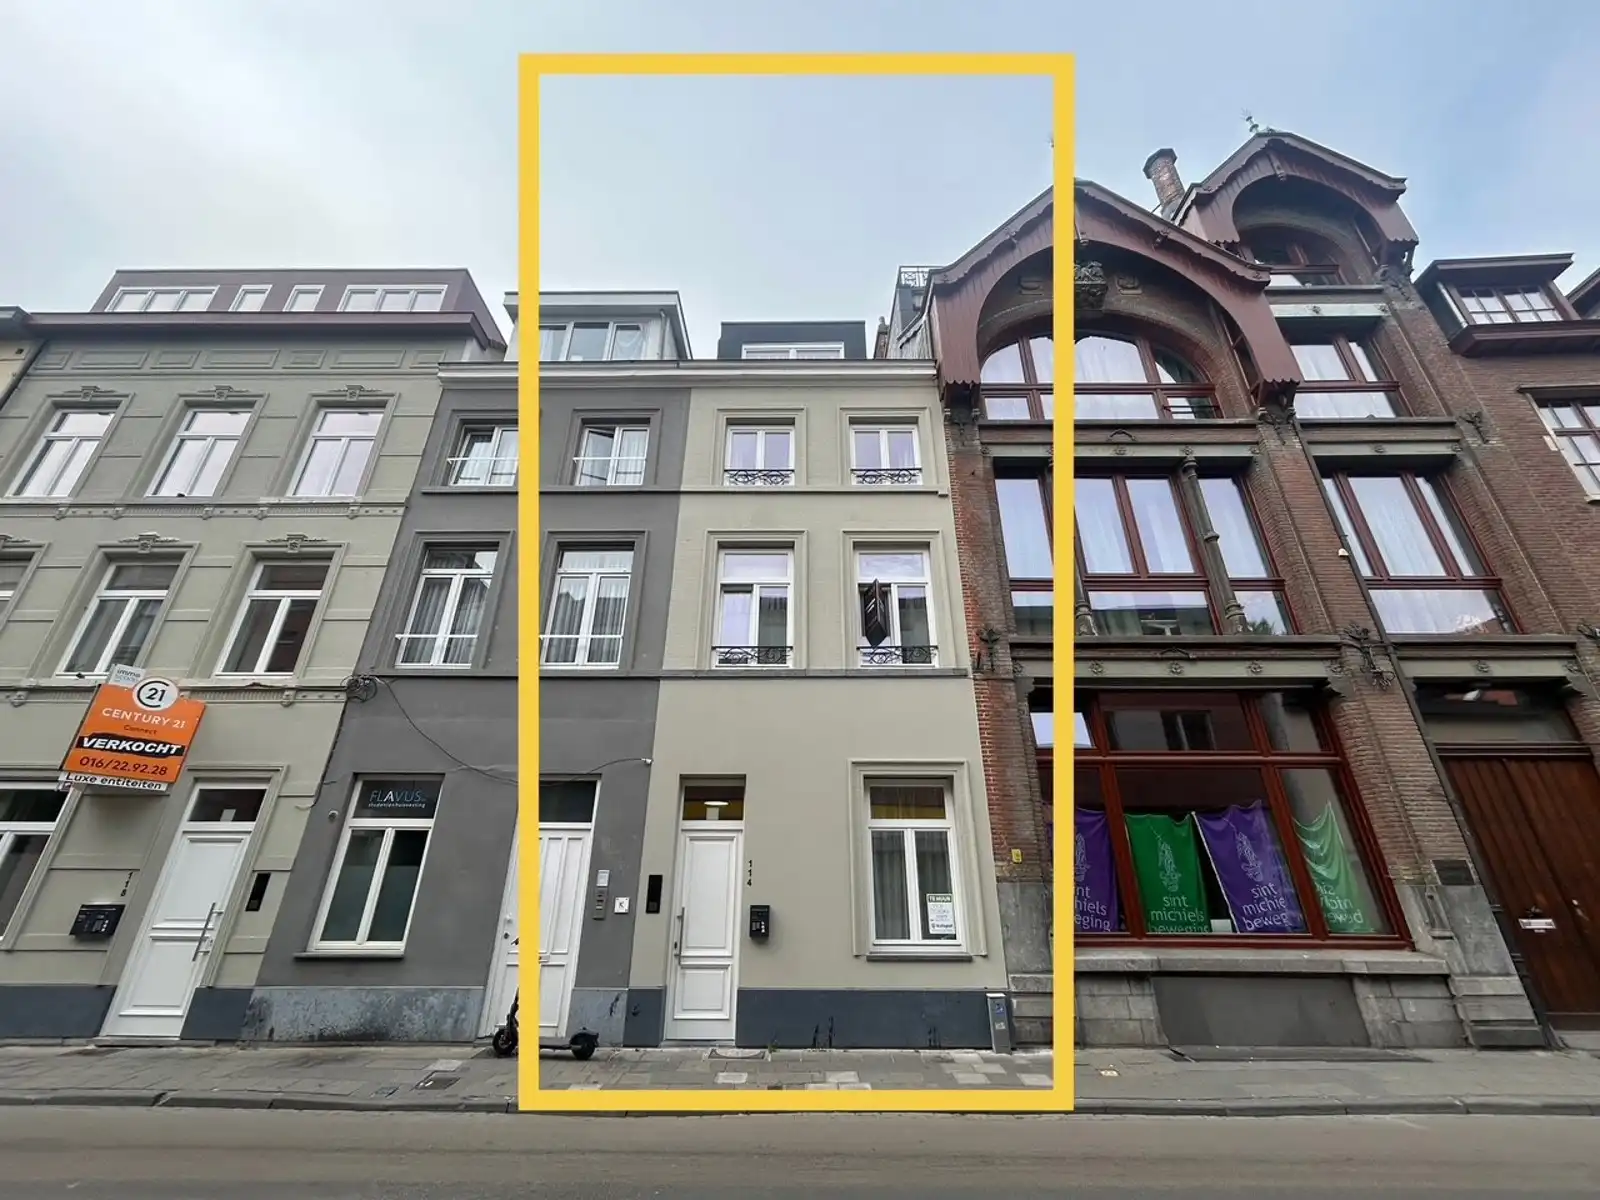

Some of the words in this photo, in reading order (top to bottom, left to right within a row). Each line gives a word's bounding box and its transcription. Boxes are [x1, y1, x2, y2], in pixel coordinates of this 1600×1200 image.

[146, 688, 166, 702] 21
[102, 708, 170, 725] CENTURY
[172, 720, 186, 729] 21
[123, 725, 158, 735] Connect
[82, 737, 182, 755] VERKOCHT
[79, 756, 169, 776] 016/22.92.28
[65, 773, 98, 784] Luxe
[101, 776, 162, 790] entiteiten
[369, 790, 423, 802] FLAVUS
[1250, 882, 1278, 899] sint
[1074, 899, 1108, 916] hiels
[1163, 894, 1189, 908] sint
[1242, 896, 1287, 916] michie
[1074, 914, 1111, 932] eging
[1150, 908, 1205, 922] michiels
[1242, 912, 1293, 932] beweg
